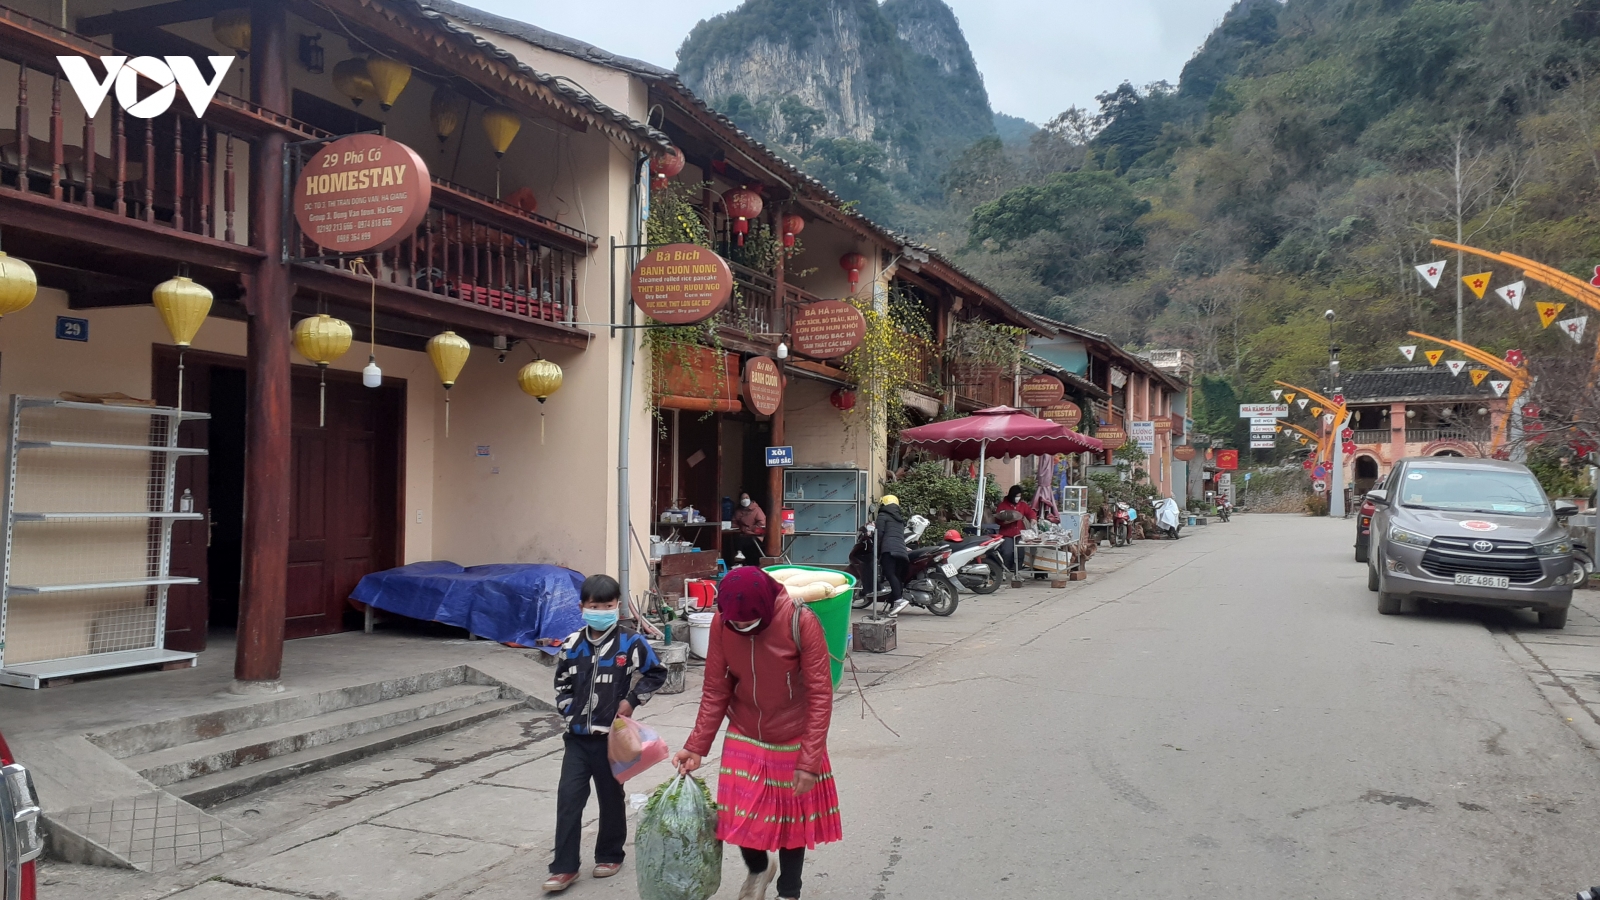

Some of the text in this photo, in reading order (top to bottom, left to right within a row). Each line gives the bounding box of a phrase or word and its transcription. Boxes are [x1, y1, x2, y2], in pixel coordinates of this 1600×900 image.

[322, 154, 339, 168] 29
[306, 164, 406, 196] HOMESTAY
[309, 214, 326, 222] Group
[333, 211, 348, 220] Dong
[386, 205, 403, 214] Giang
[64, 322, 81, 336] 29
[1456, 574, 1507, 588] 30E-486.16
